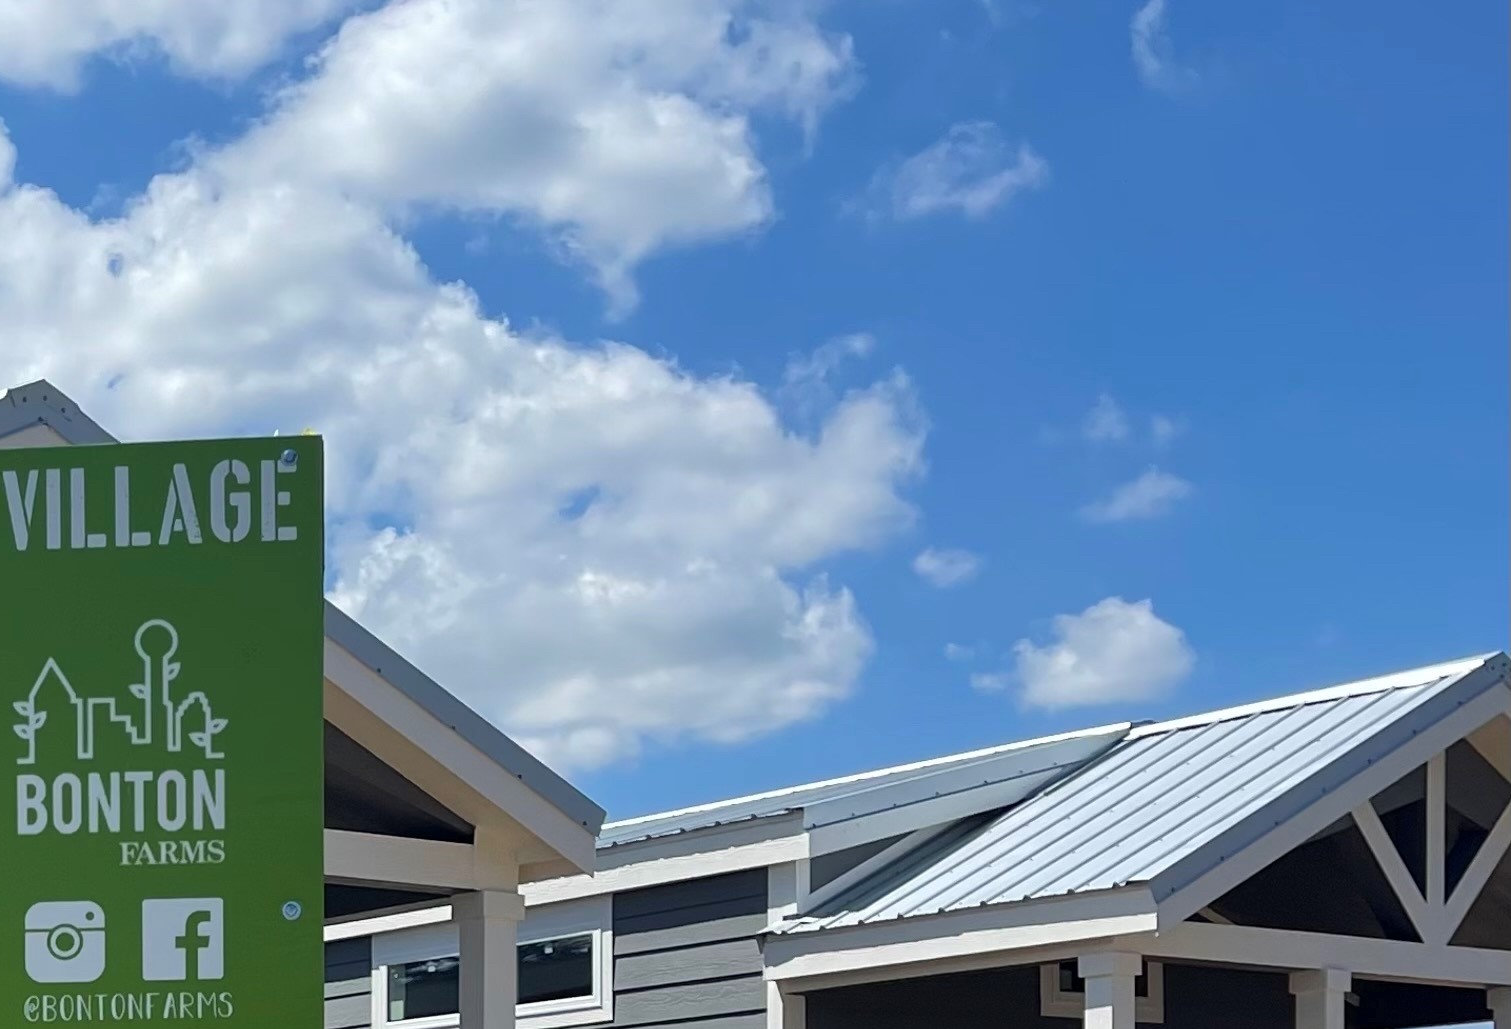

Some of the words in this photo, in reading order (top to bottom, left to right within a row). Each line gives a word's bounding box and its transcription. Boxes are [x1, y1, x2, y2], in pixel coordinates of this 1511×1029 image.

[2, 459, 297, 551] VILLAGE
[17, 769, 226, 835] BONTON
[119, 840, 226, 866] FARMS
[23, 992, 234, 1022] @BONTONFARMS
